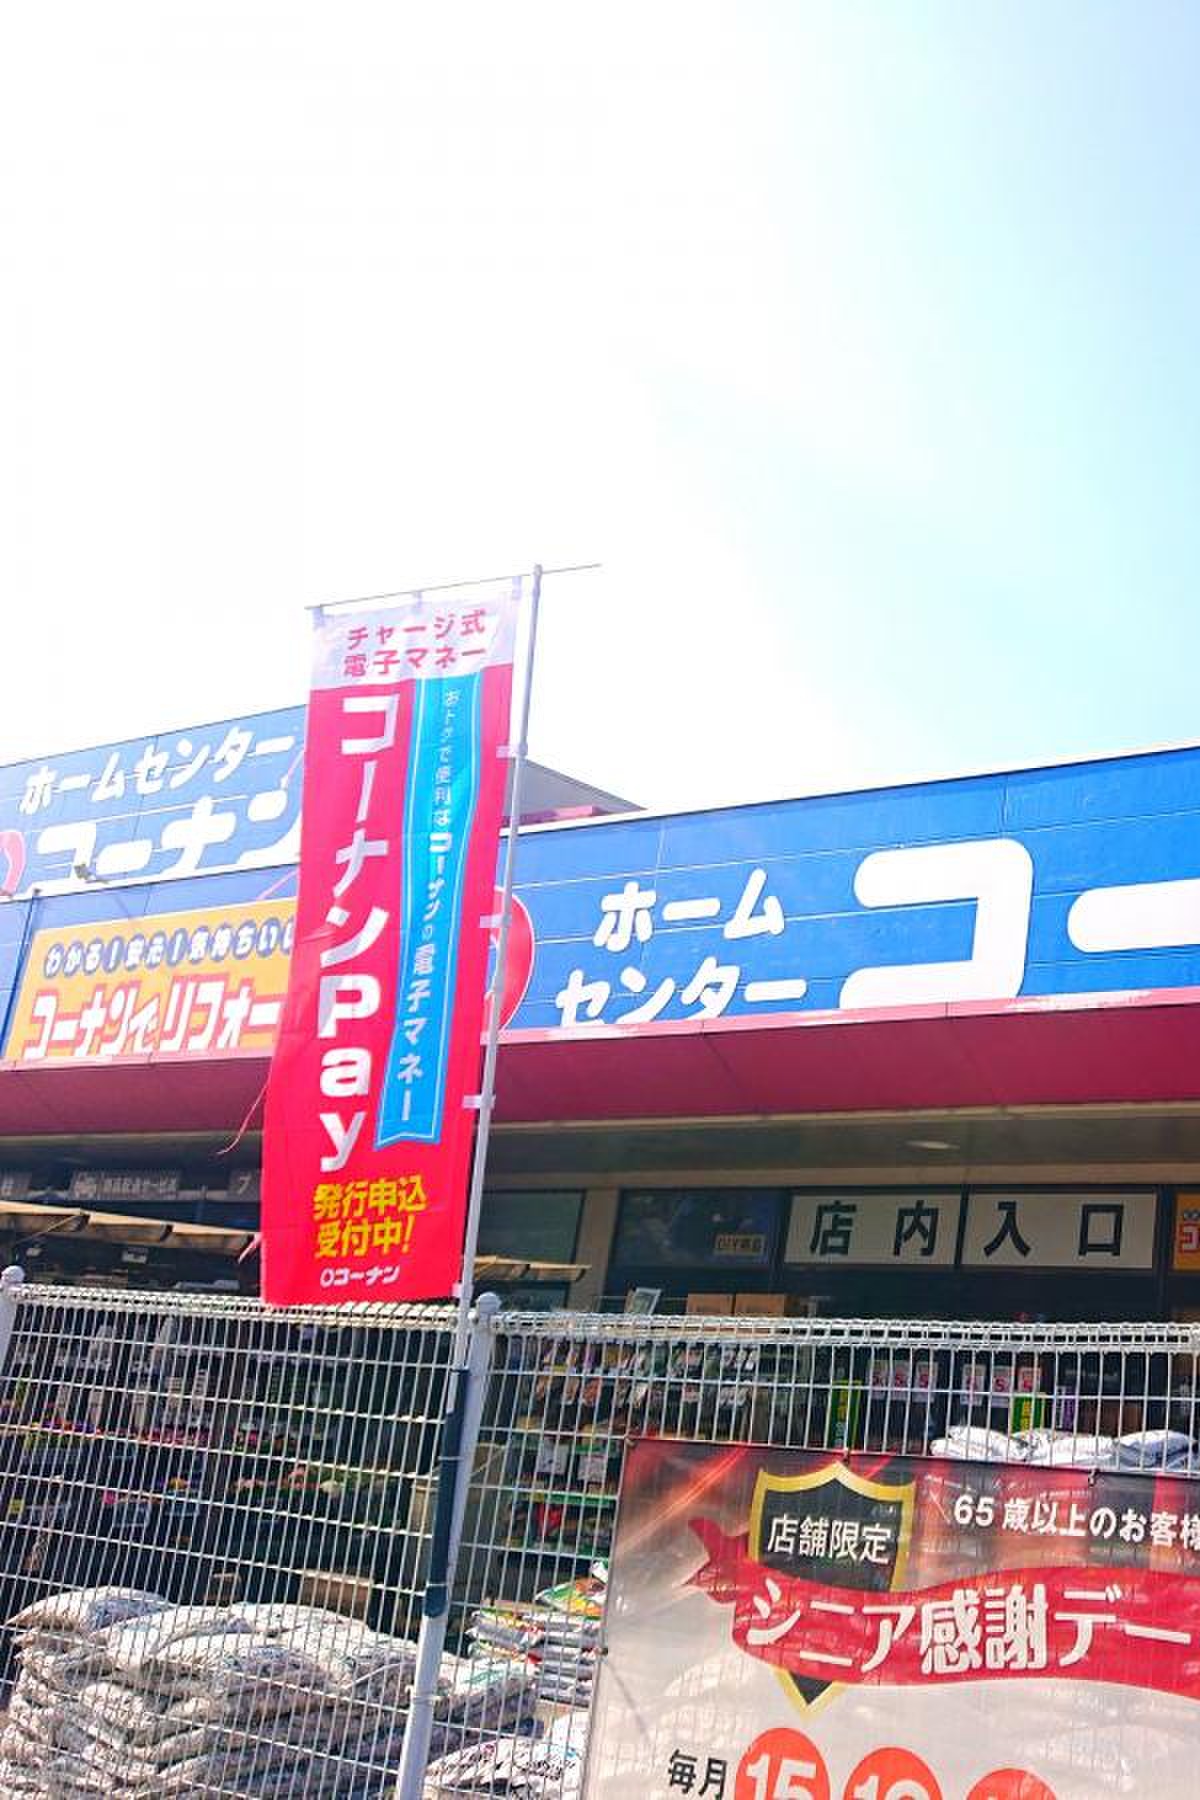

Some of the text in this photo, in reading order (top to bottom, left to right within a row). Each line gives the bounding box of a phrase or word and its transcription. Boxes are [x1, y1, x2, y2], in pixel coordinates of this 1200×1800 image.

[347, 608, 487, 650] チャージ式
[343, 646, 487, 677] 電子マネー
[18, 726, 295, 815] ホームセンター
[317, 692, 399, 1173] コーナンPay
[592, 867, 785, 953] ホーム
[554, 955, 807, 1028] センター
[312, 1174, 428, 1220] 発行申込
[315, 1214, 416, 1258] 受付中!
[767, 1515, 893, 1567] 店舗限定
[746, 1577, 1192, 1674] シニア感謝デー
[666, 1748, 729, 1800] 毎月
